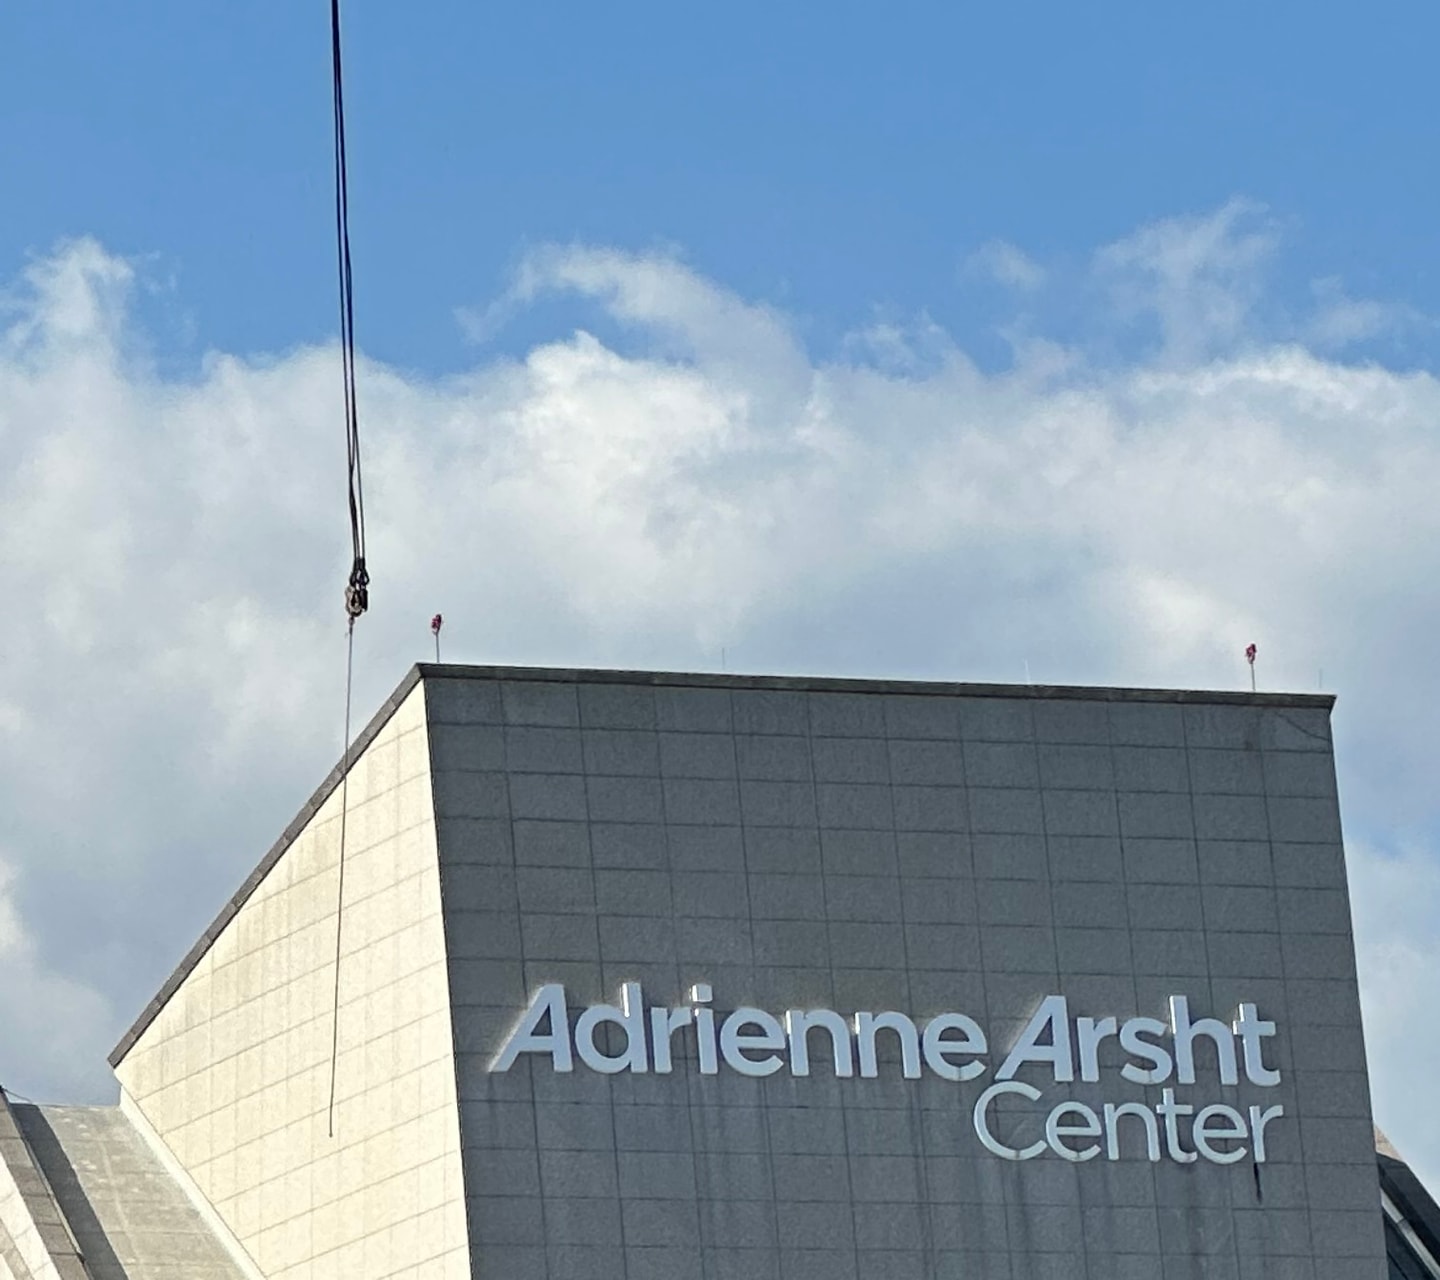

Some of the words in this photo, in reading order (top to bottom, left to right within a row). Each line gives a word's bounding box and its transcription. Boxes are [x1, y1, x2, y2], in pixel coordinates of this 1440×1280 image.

[488, 982, 988, 1081] Adrienne
[995, 995, 1281, 1086] Arsht
[973, 1081, 1283, 1164] Center
